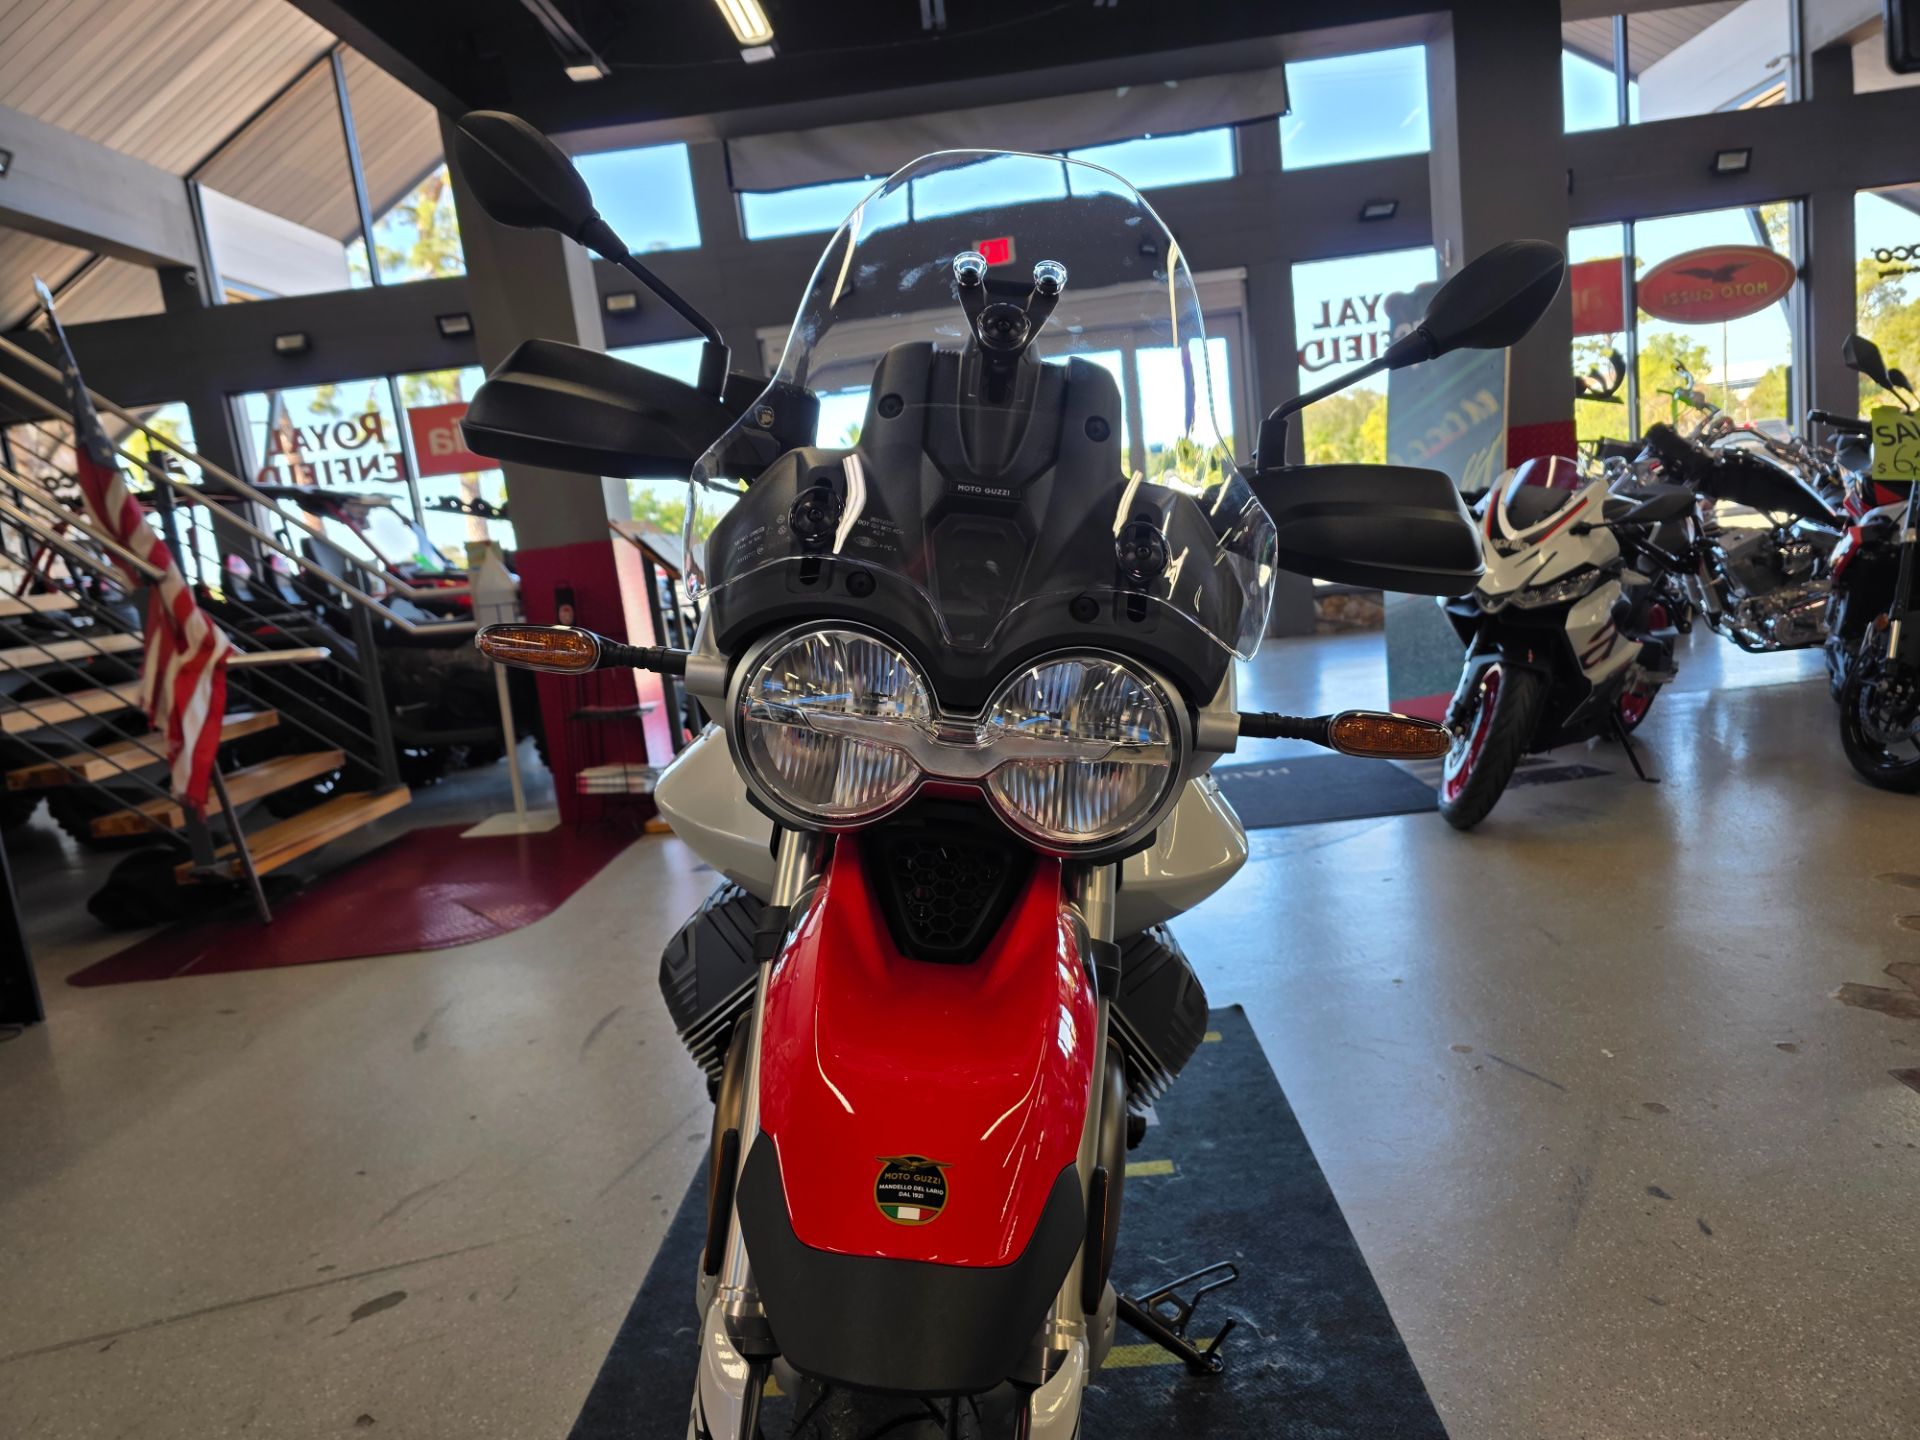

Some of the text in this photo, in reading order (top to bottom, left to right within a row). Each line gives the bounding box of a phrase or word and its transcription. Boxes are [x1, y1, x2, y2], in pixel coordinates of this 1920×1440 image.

[957, 484, 1010, 497] MOTO GUZZI
[884, 1172, 941, 1185] MOTO GUZZI
[913, 1185, 925, 1193] DEL
[926, 1187, 944, 1196] LARIO
